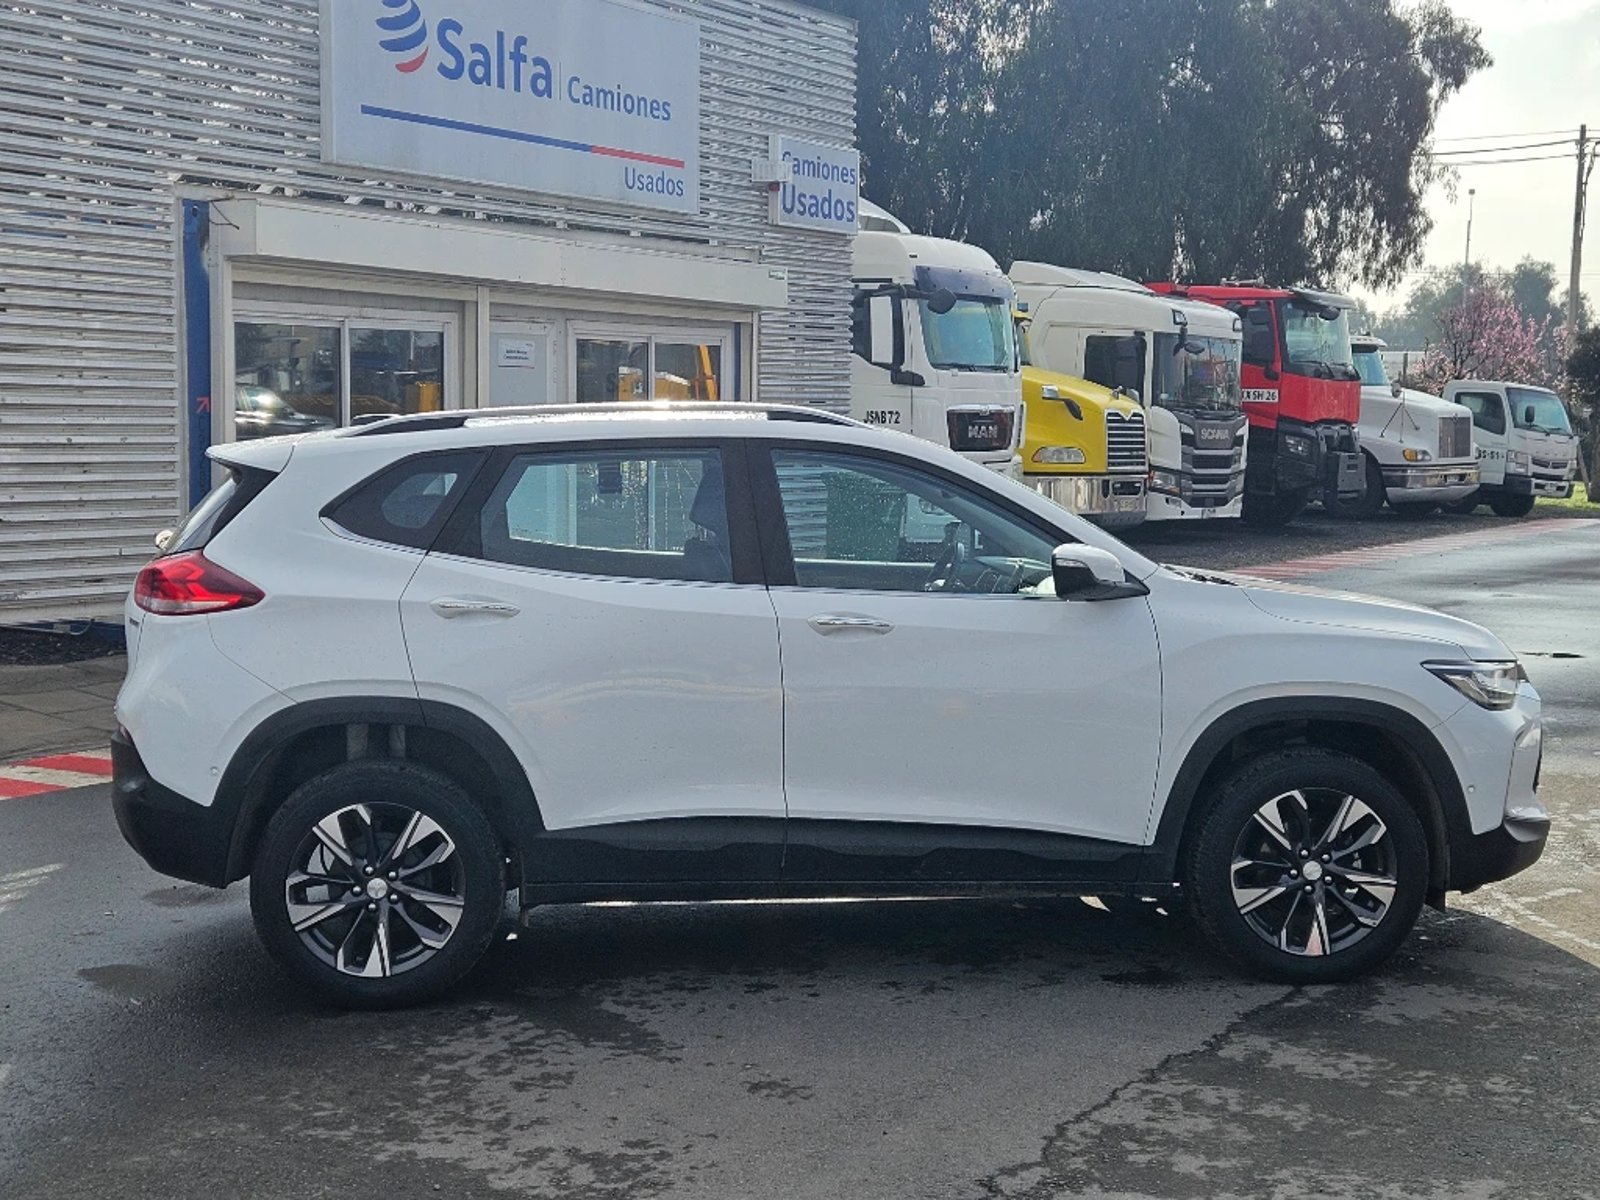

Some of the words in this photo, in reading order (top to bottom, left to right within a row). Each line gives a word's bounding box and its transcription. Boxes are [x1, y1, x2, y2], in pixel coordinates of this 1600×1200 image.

[437, 18, 553, 99] Salfa
[567, 75, 672, 121] Camiones
[624, 166, 685, 197] Usados
[781, 182, 856, 222] Usados
[968, 425, 998, 439] MAN
